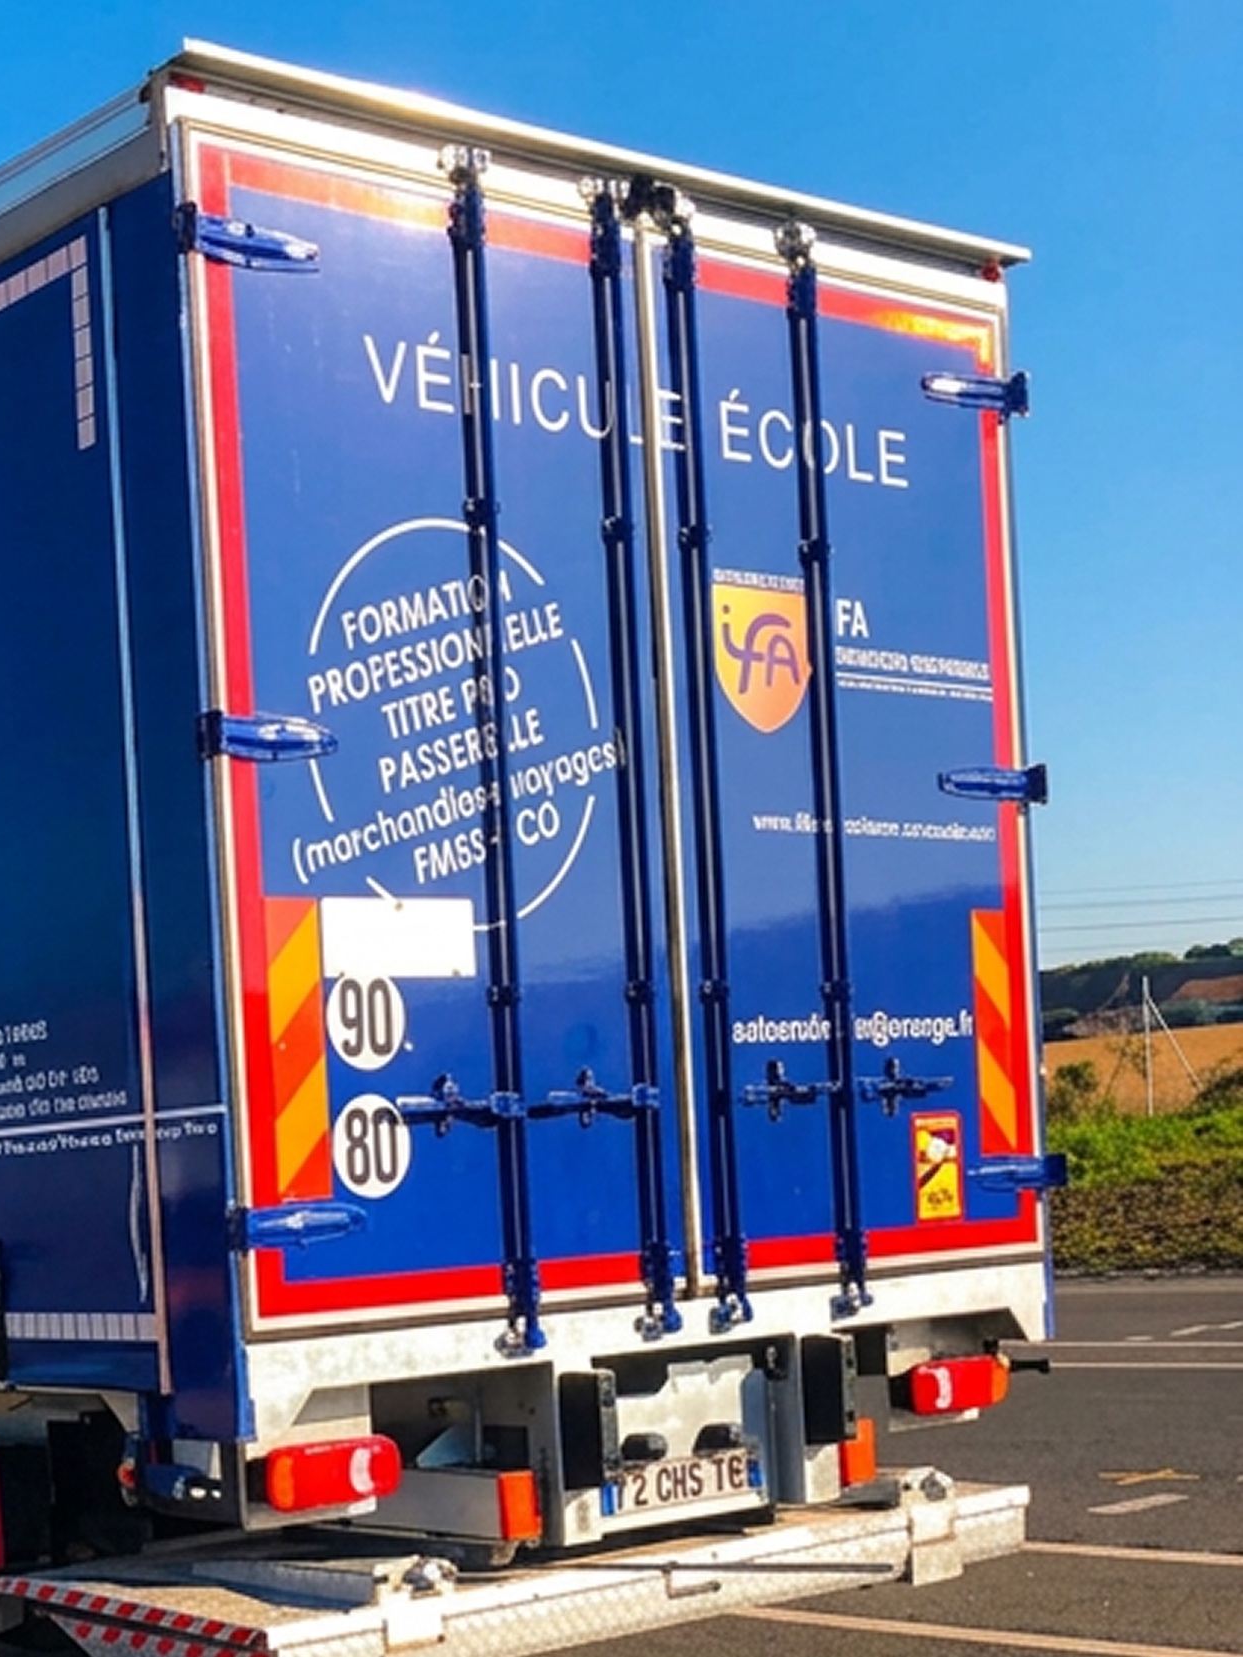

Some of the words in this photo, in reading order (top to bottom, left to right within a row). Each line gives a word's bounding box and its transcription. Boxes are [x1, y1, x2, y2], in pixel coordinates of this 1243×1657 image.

[720, 389, 909, 488] ÉCOLE
[382, 686, 456, 739] TITRE
[339, 978, 393, 1057] 90
[345, 1107, 399, 1185] 80
